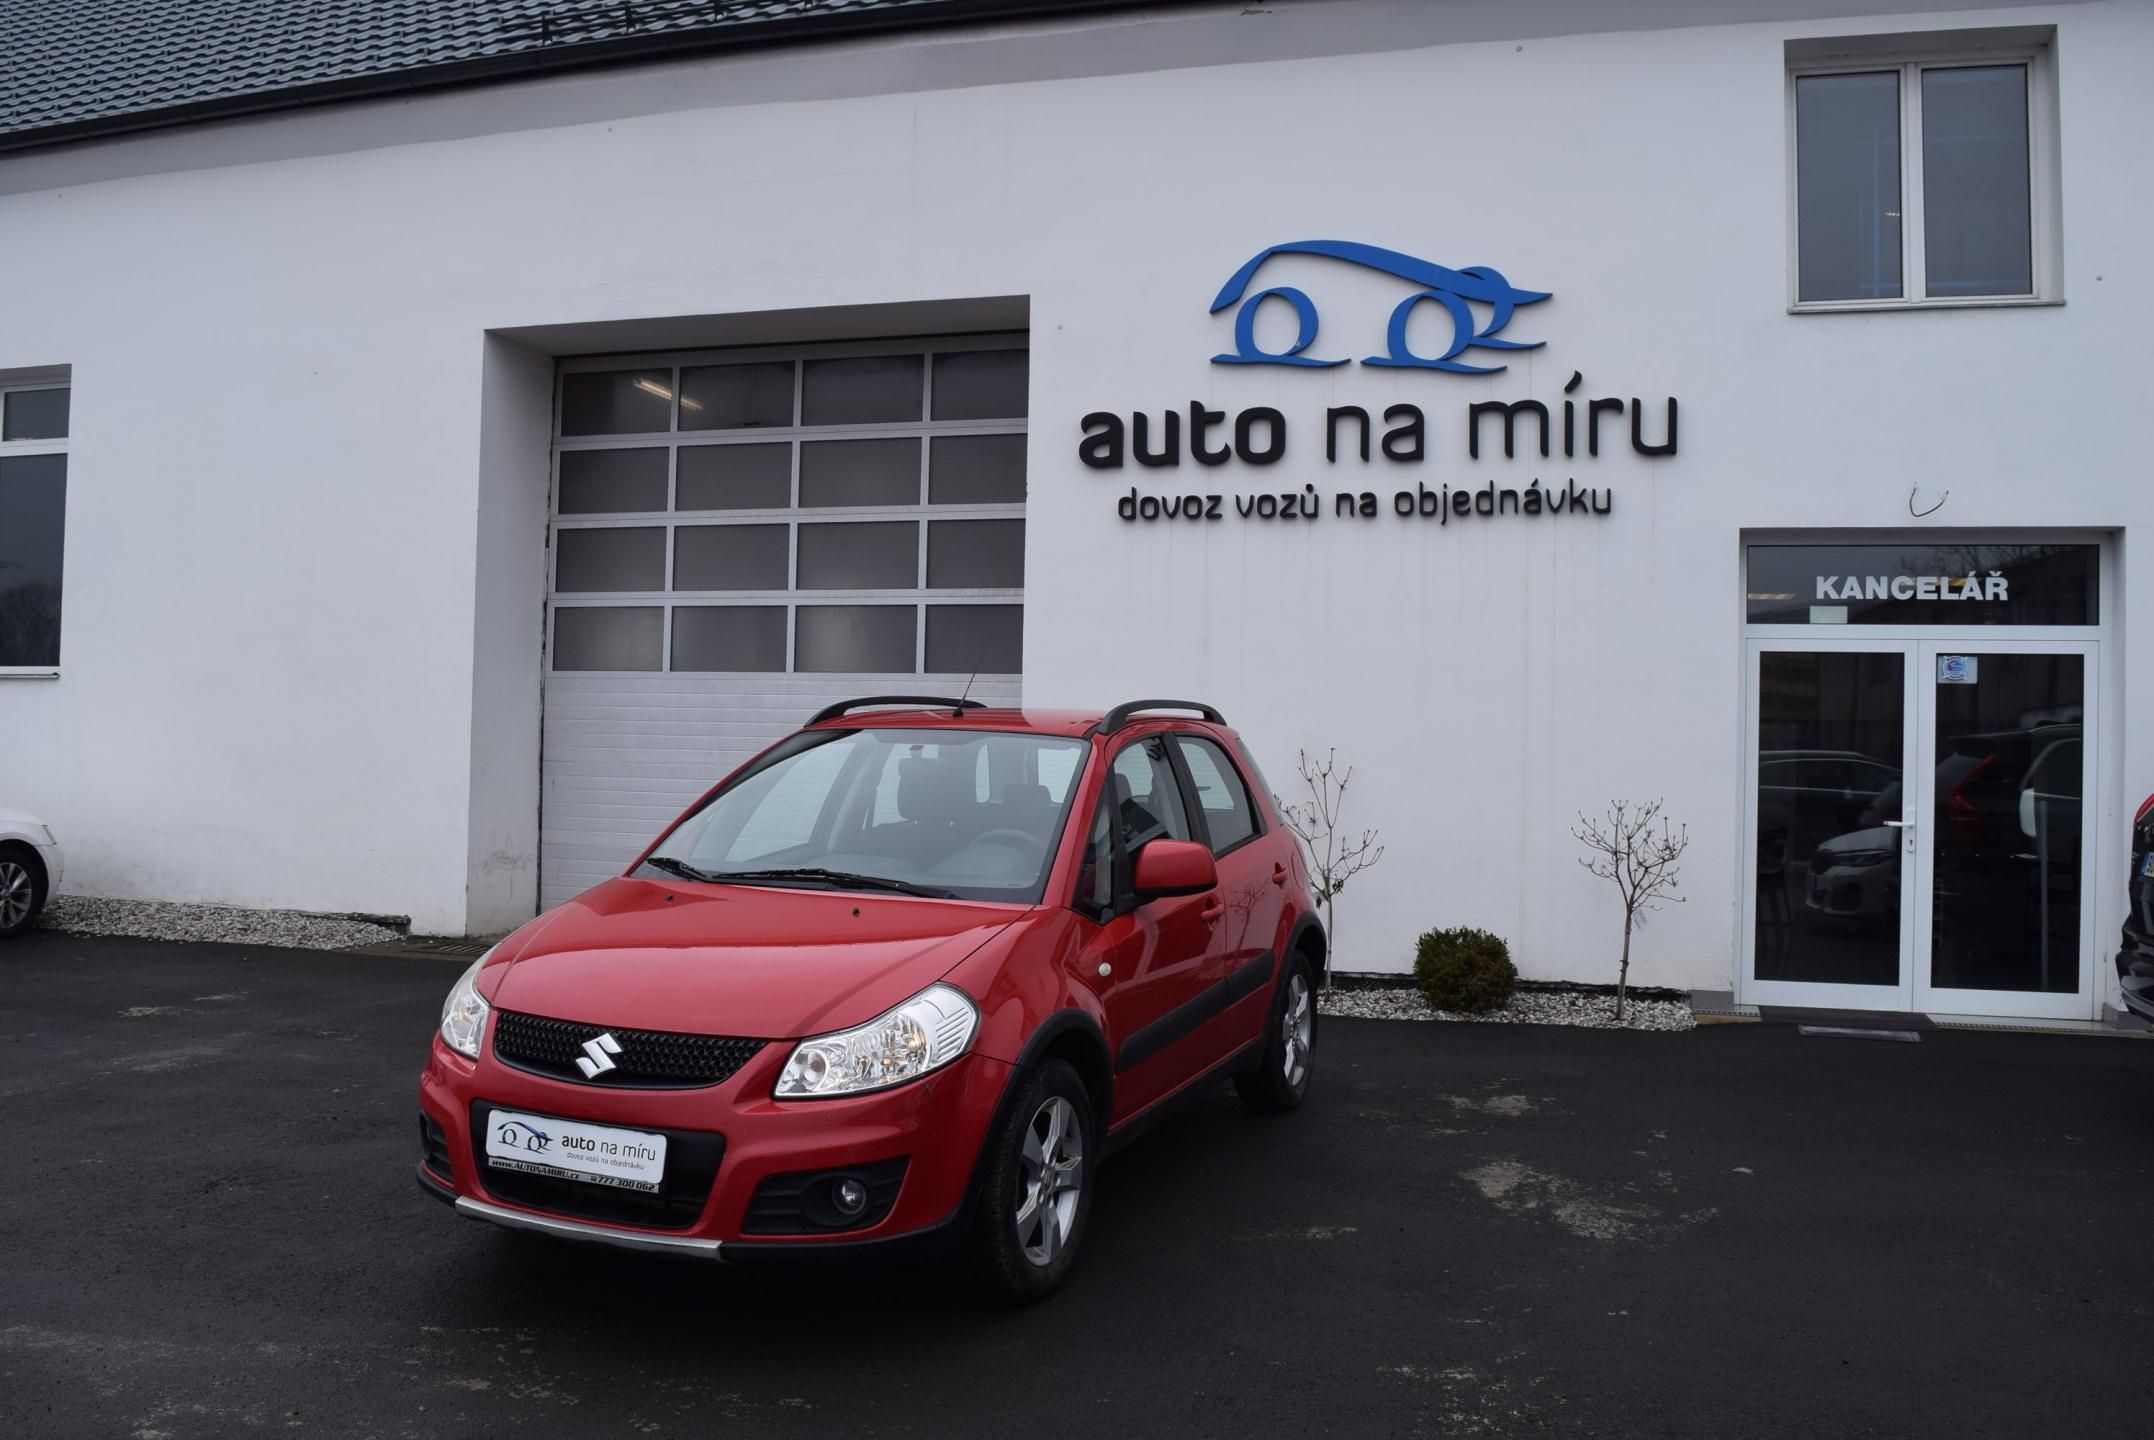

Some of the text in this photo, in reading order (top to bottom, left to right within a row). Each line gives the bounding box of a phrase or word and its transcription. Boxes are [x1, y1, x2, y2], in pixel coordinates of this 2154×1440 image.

[1079, 370, 1678, 470] auto na míru
[1118, 478, 1612, 526] dovoz vozů na objednávku
[1816, 570, 2008, 601] KANCELÁŘ
[562, 1135, 656, 1161] auto na míru
[567, 1152, 585, 1161] dovoz
[586, 1155, 599, 1163] vozů
[610, 1159, 644, 1170] objednávku
[492, 1160, 655, 1192] www.AUTONAMIRU.cz 777 300 062
